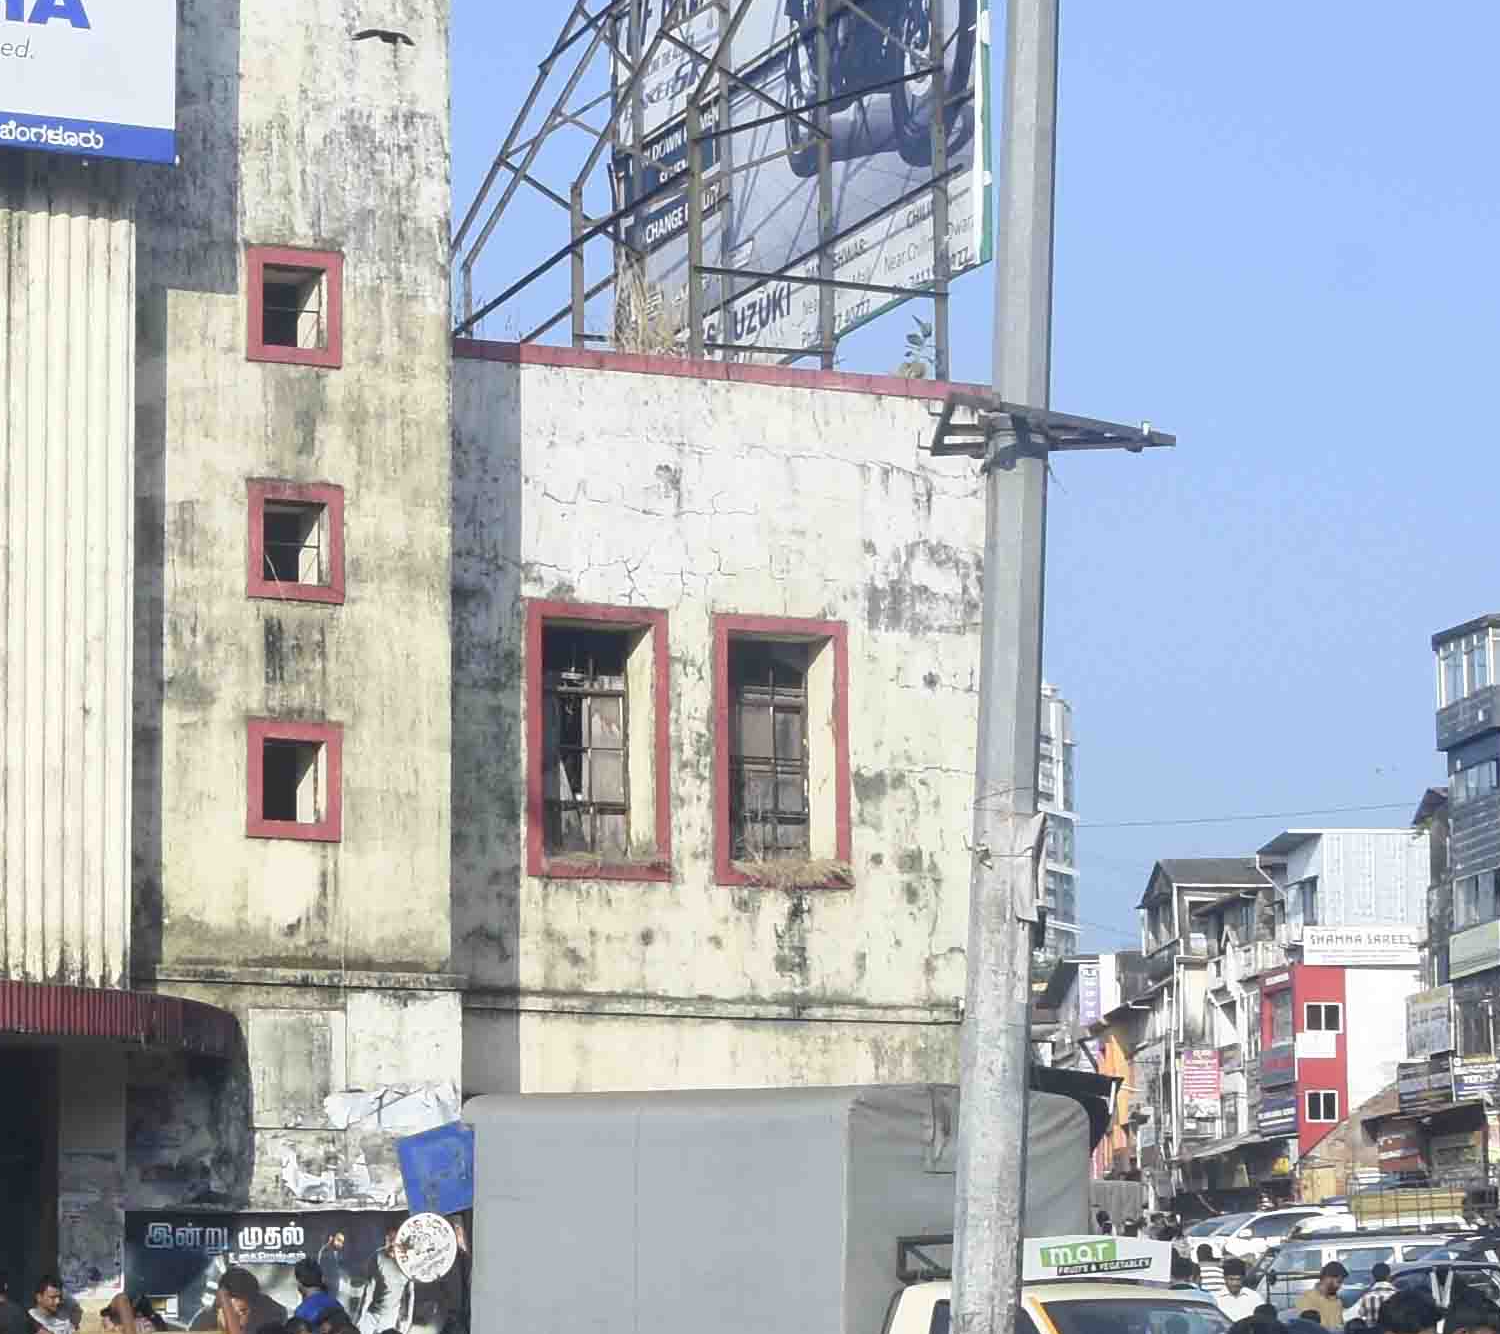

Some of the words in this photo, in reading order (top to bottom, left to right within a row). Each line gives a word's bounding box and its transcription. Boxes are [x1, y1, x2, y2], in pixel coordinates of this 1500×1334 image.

[0, 123, 104, 150] ಬೆಂಗಳೂರು
[144, 1222, 230, 1254] இன்று
[238, 1221, 305, 1250] முதல்
